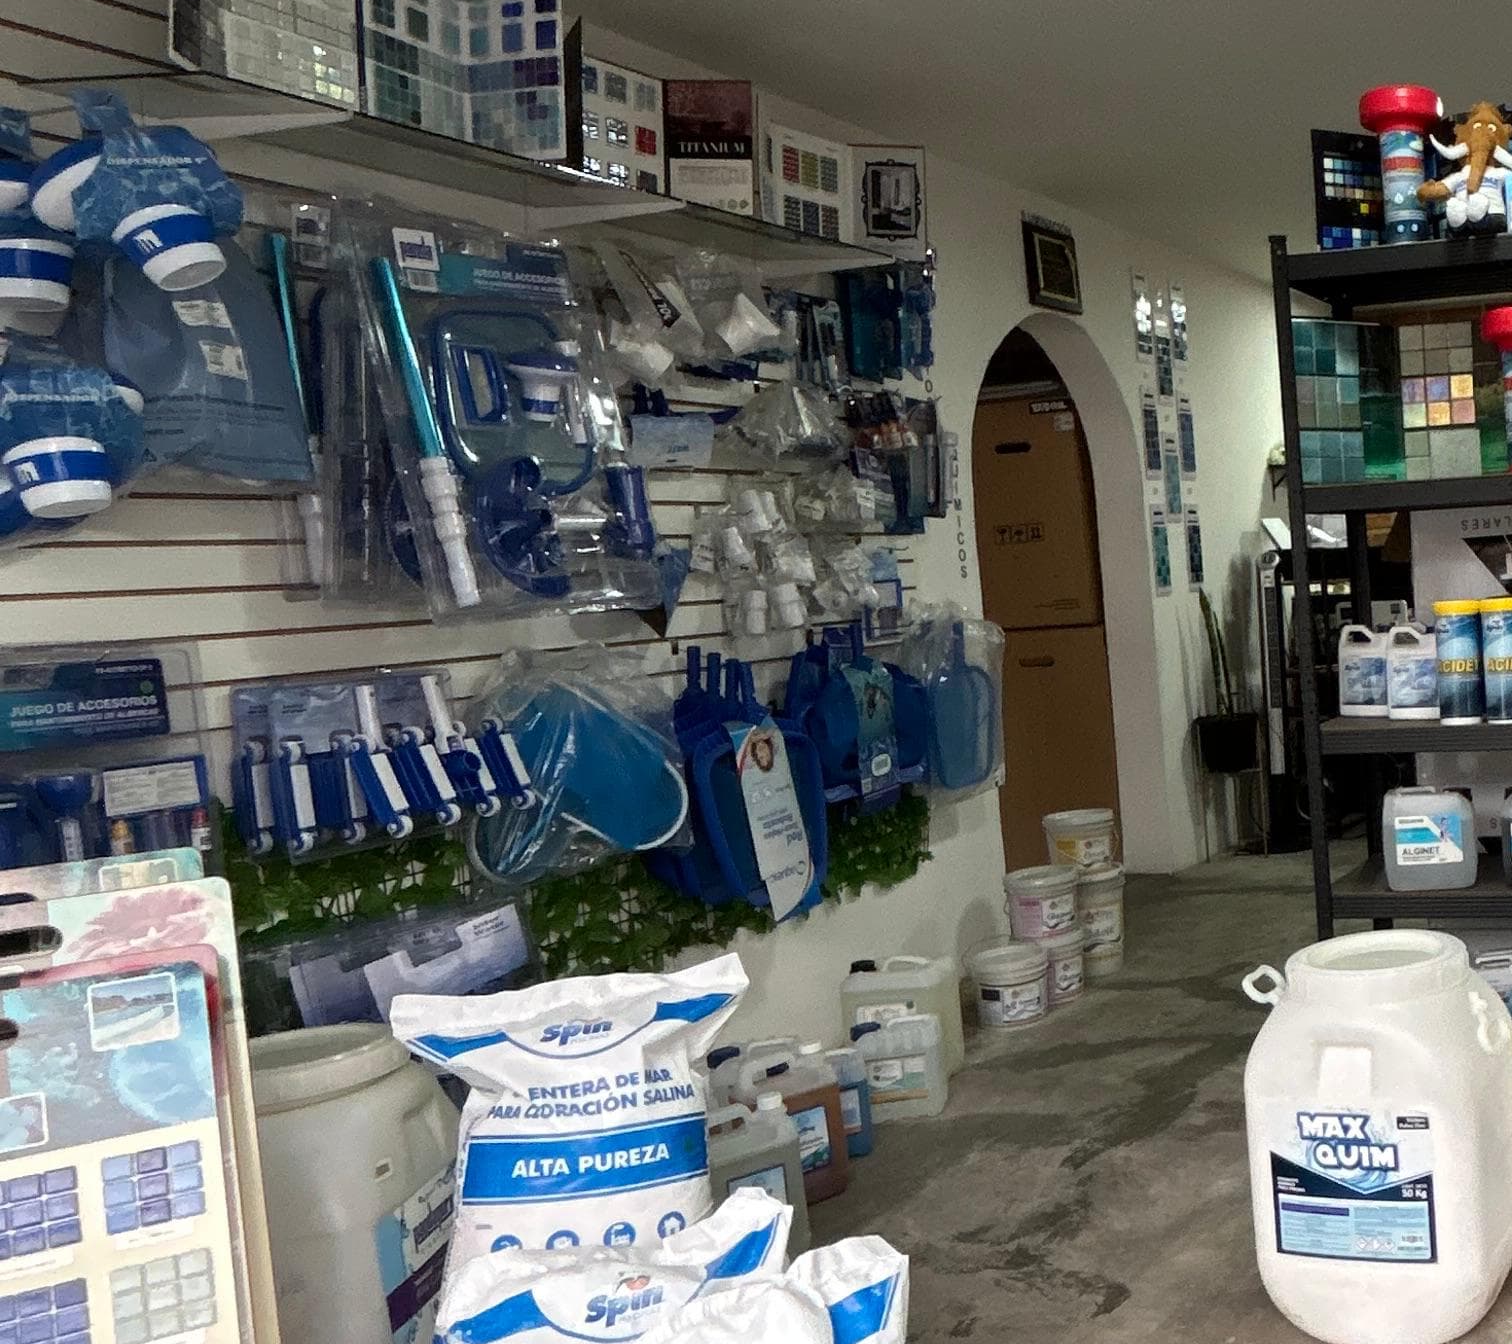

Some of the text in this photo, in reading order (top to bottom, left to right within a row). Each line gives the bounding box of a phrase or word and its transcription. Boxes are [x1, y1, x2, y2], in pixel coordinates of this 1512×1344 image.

[679, 141, 745, 154] TITANIUM
[10, 695, 158, 717] JUEGO DE ACCESORIOS
[528, 1077, 611, 1102] ENTERA
[615, 1071, 641, 1088] DE
[643, 1083, 695, 1106] SALINA
[1298, 1112, 1370, 1141] MAX
[511, 1142, 671, 1179] ALTA PUREZA
[1313, 1142, 1400, 1171] QUIM
[1415, 1189, 1428, 1200] Kg
